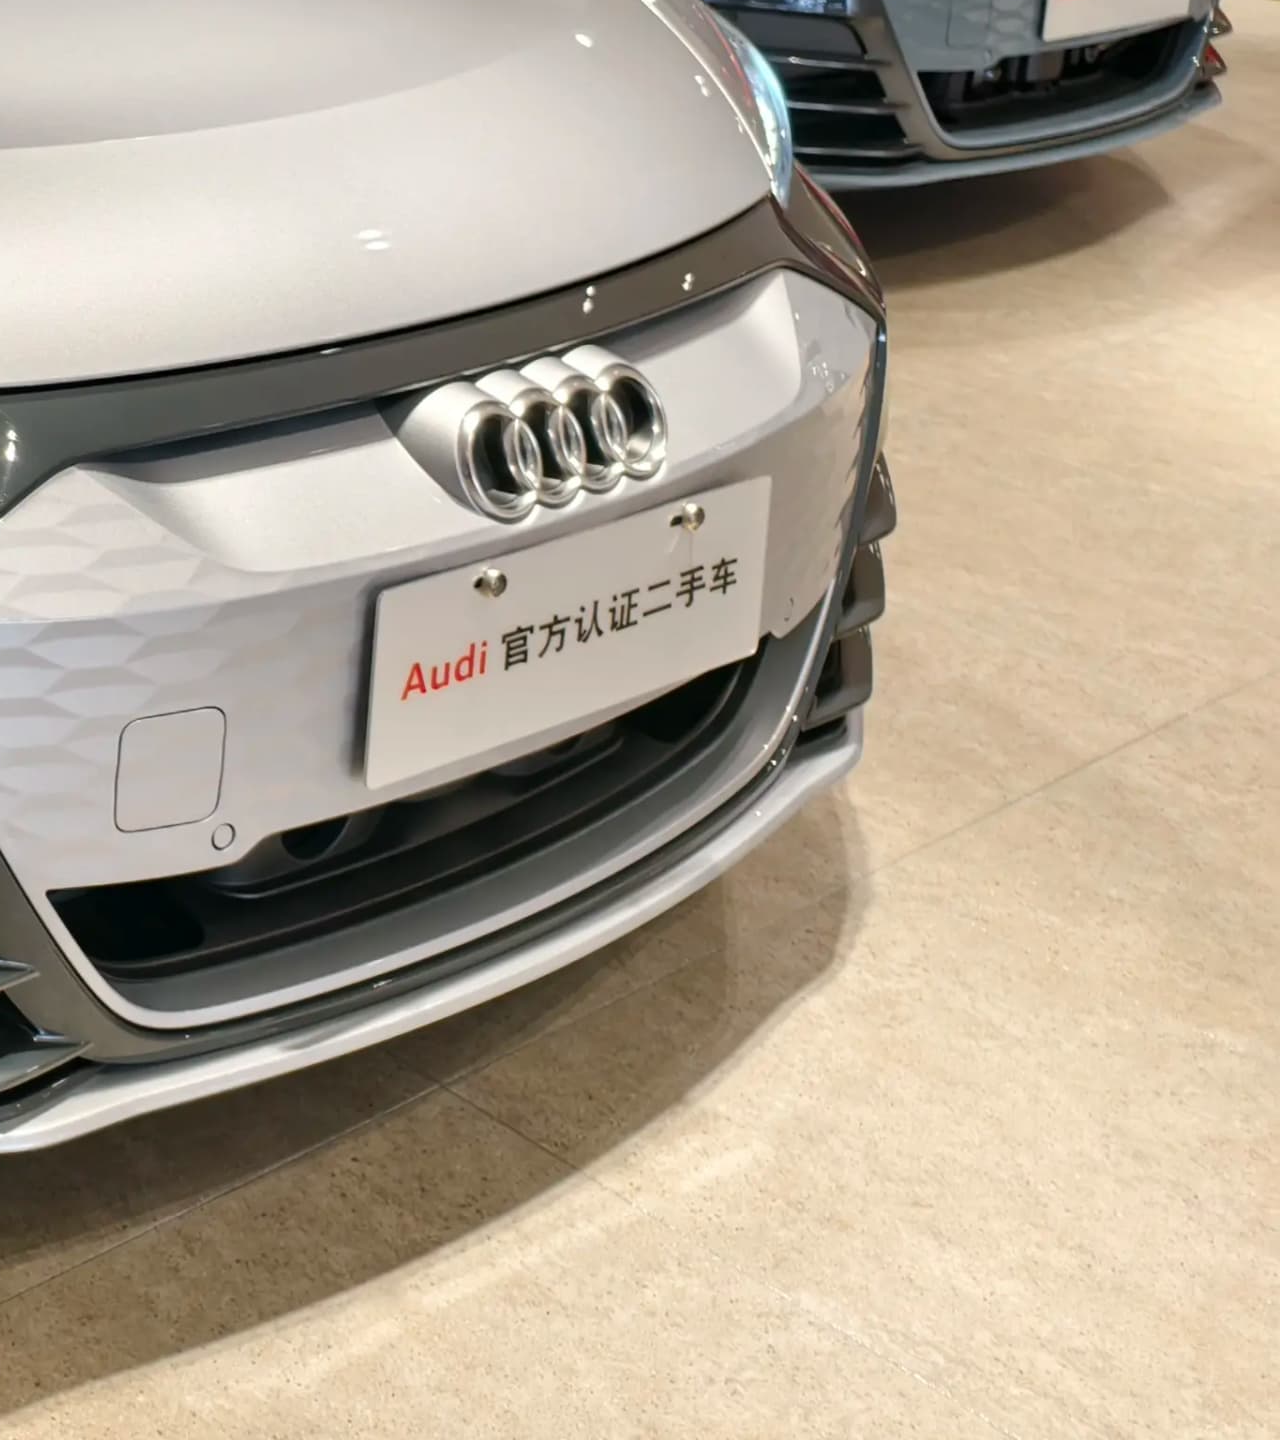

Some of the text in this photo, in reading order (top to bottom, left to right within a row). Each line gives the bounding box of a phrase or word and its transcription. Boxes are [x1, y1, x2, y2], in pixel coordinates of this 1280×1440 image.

[401, 557, 739, 700] Audi 官方认证二手车
